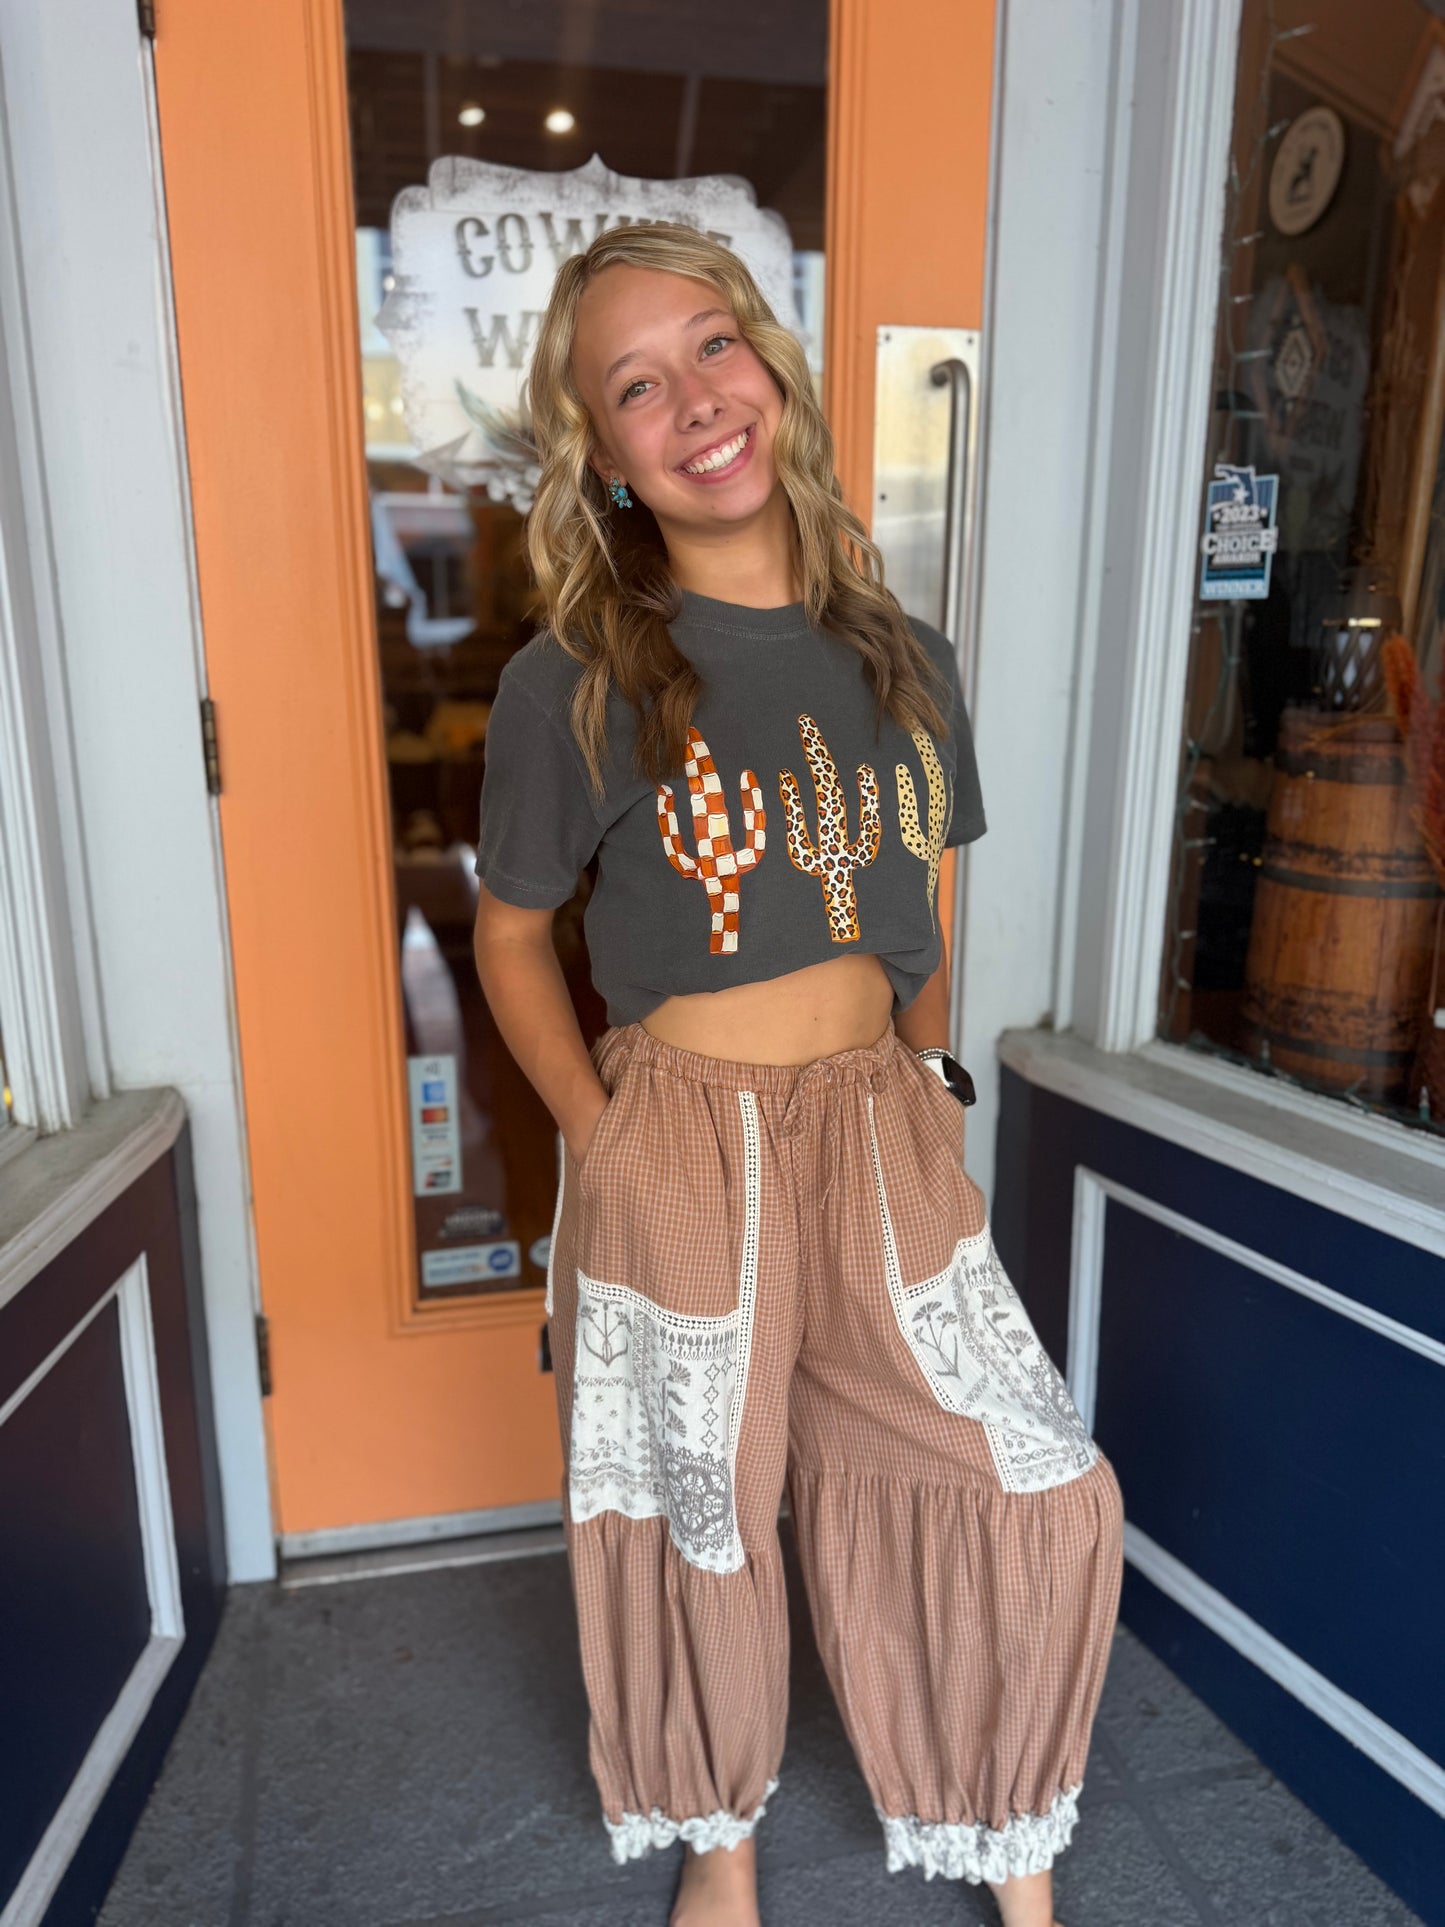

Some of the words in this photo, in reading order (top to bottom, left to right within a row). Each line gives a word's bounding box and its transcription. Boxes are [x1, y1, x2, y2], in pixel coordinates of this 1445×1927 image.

[1220, 504, 1260, 524] 2023
[1202, 527, 1278, 554] CHOICE
[1204, 580, 1265, 595] WINNER
